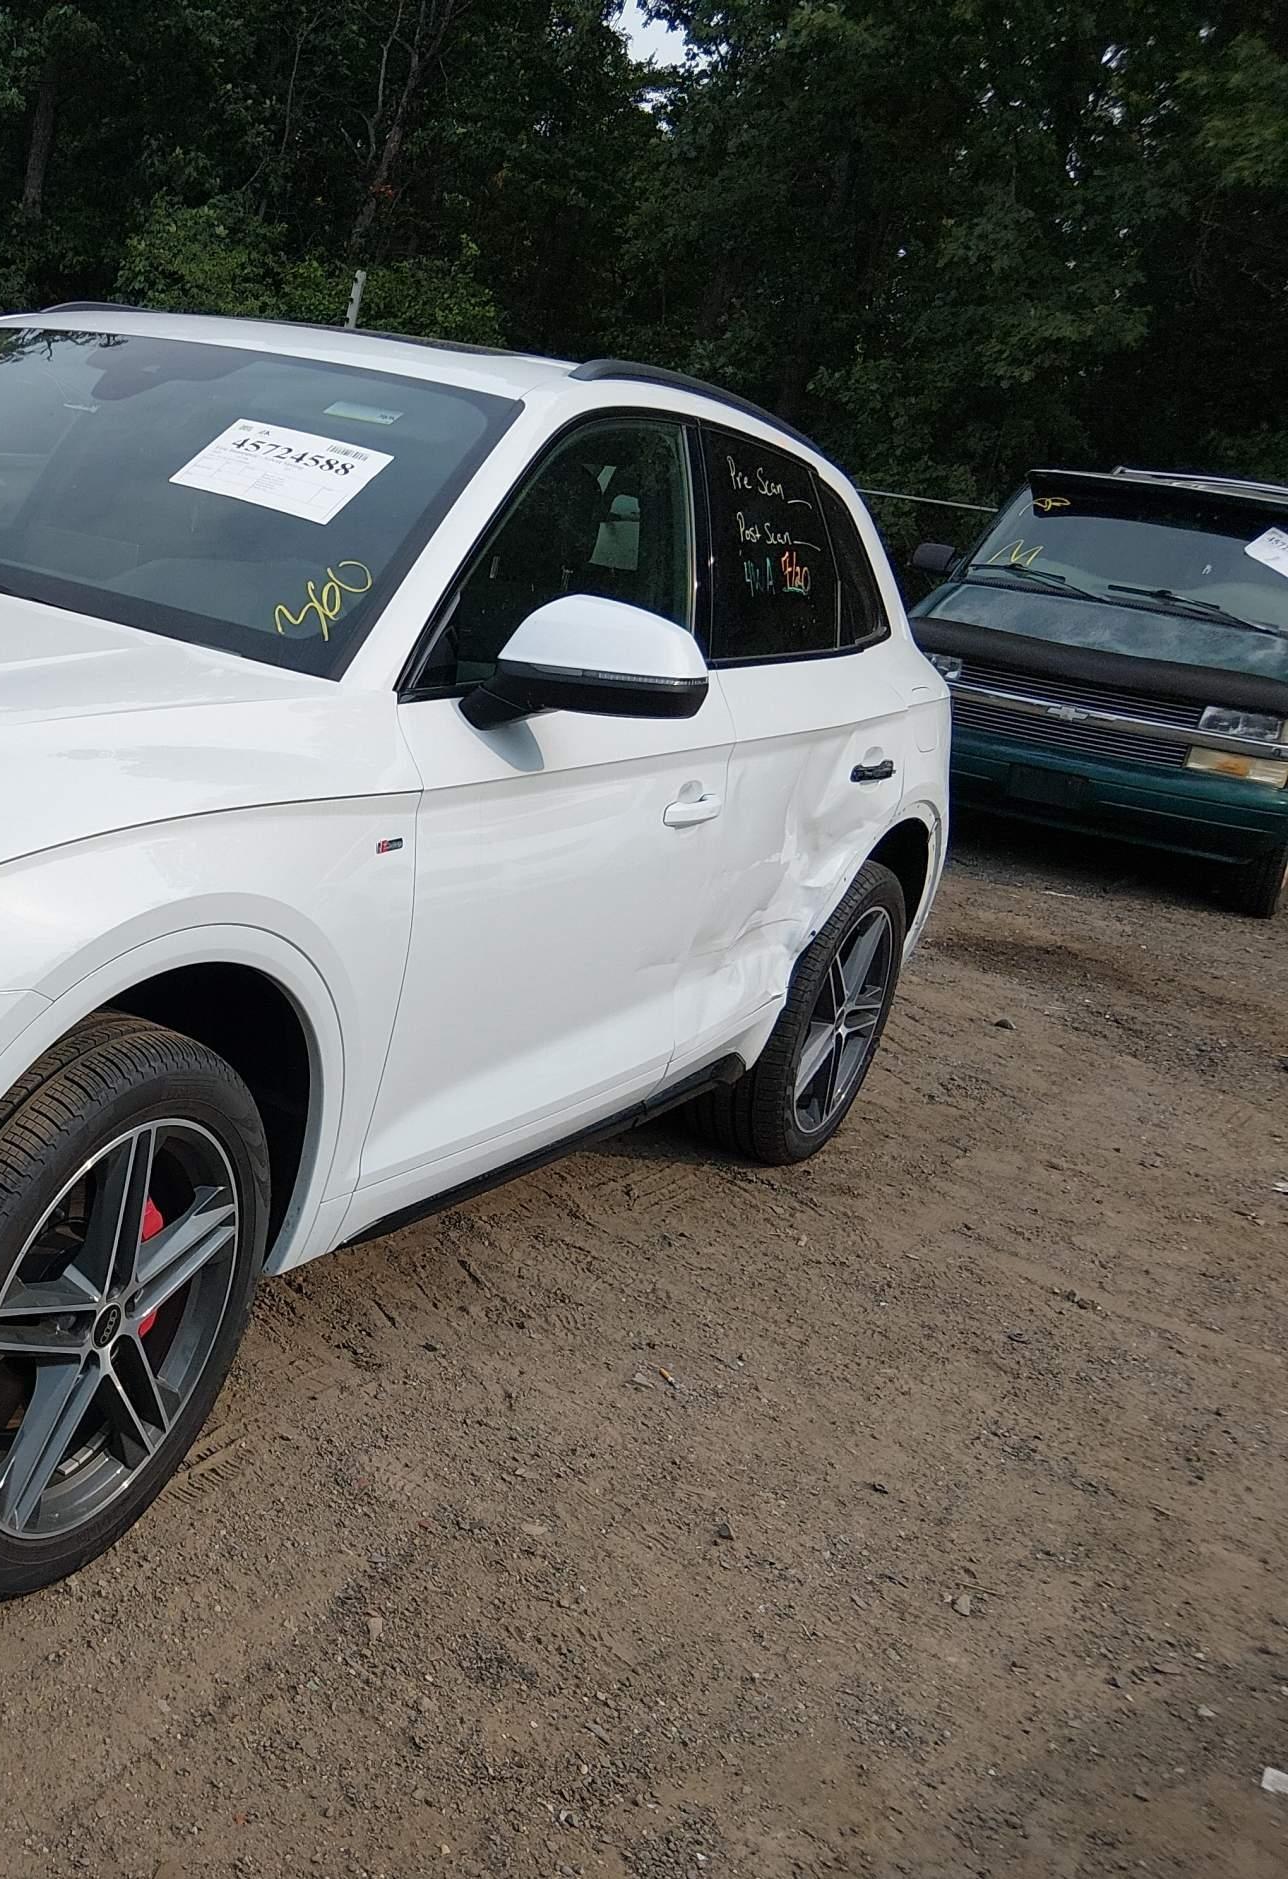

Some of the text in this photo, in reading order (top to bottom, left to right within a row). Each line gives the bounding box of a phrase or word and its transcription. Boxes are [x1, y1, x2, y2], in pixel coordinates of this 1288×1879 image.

[232, 437, 355, 477] 45724588
[727, 455, 785, 500] Pre Scan
[736, 511, 792, 545] Post Scan
[275, 561, 372, 641] 360
